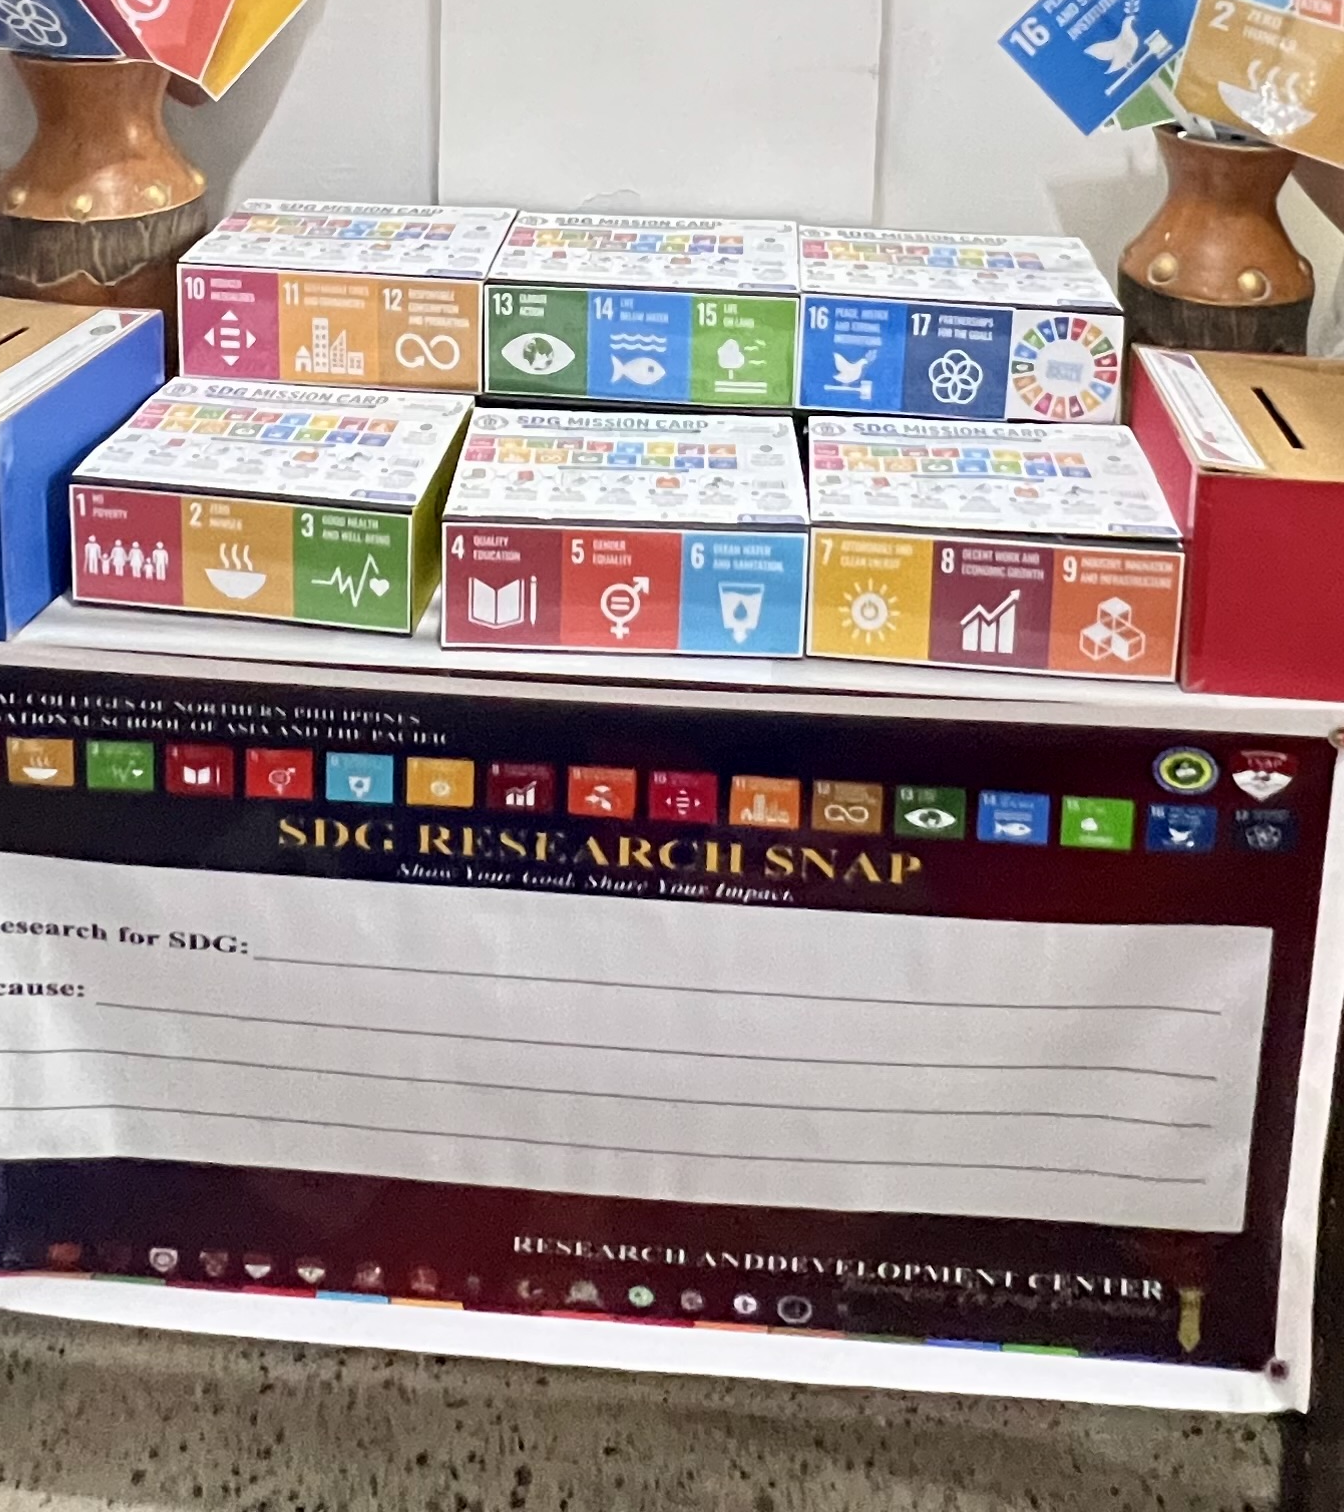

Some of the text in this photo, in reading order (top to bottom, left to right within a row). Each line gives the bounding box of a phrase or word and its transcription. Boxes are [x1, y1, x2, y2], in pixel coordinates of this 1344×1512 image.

[1209, 0, 1236, 32] 2
[1247, 9, 1283, 29] ZERO
[1009, 17, 1050, 57] 16
[184, 276, 205, 300] 10
[283, 281, 299, 306] 11
[383, 288, 402, 313] 12
[493, 292, 513, 316] 13
[593, 297, 614, 320] 14
[696, 302, 717, 327] 15
[808, 305, 829, 330] 16
[911, 313, 932, 336] 17
[206, 384, 389, 406] SDG MISSION CARD
[517, 414, 709, 430] SDG MISSION CARD
[852, 422, 1048, 439] SDG MISSION CARD
[76, 492, 86, 517] 1
[92, 507, 128, 521] POVERTY
[189, 502, 203, 528] 2
[301, 513, 315, 538] 3
[347, 515, 380, 530] HEALTH
[451, 535, 465, 560] 4
[473, 536, 509, 548] QUALITY
[571, 539, 584, 564] 5
[592, 539, 627, 552] GENDER
[821, 539, 833, 566] 7
[473, 549, 521, 562] EDUCATION
[592, 553, 632, 566] EQUALITY
[690, 542, 705, 569] 6
[941, 548, 955, 574] 8
[962, 549, 1041, 564] DECENT WORK AND
[961, 563, 1045, 581] ECONOMIC GROWTH
[1062, 555, 1077, 583] 9
[174, 700, 287, 717] NORTHERN
[102, 716, 180, 731] SCHOOL
[226, 723, 269, 736] ASIA
[280, 725, 319, 738] AND
[278, 816, 923, 886] SDG RESEARCH SNAP
[396, 862, 452, 880] Show
[658, 877, 710, 897] Your
[119, 926, 160, 947] for
[169, 931, 249, 954] SDG:
[514, 1236, 687, 1265] RESEARCH
[1028, 1273, 1162, 1301] CENTER
